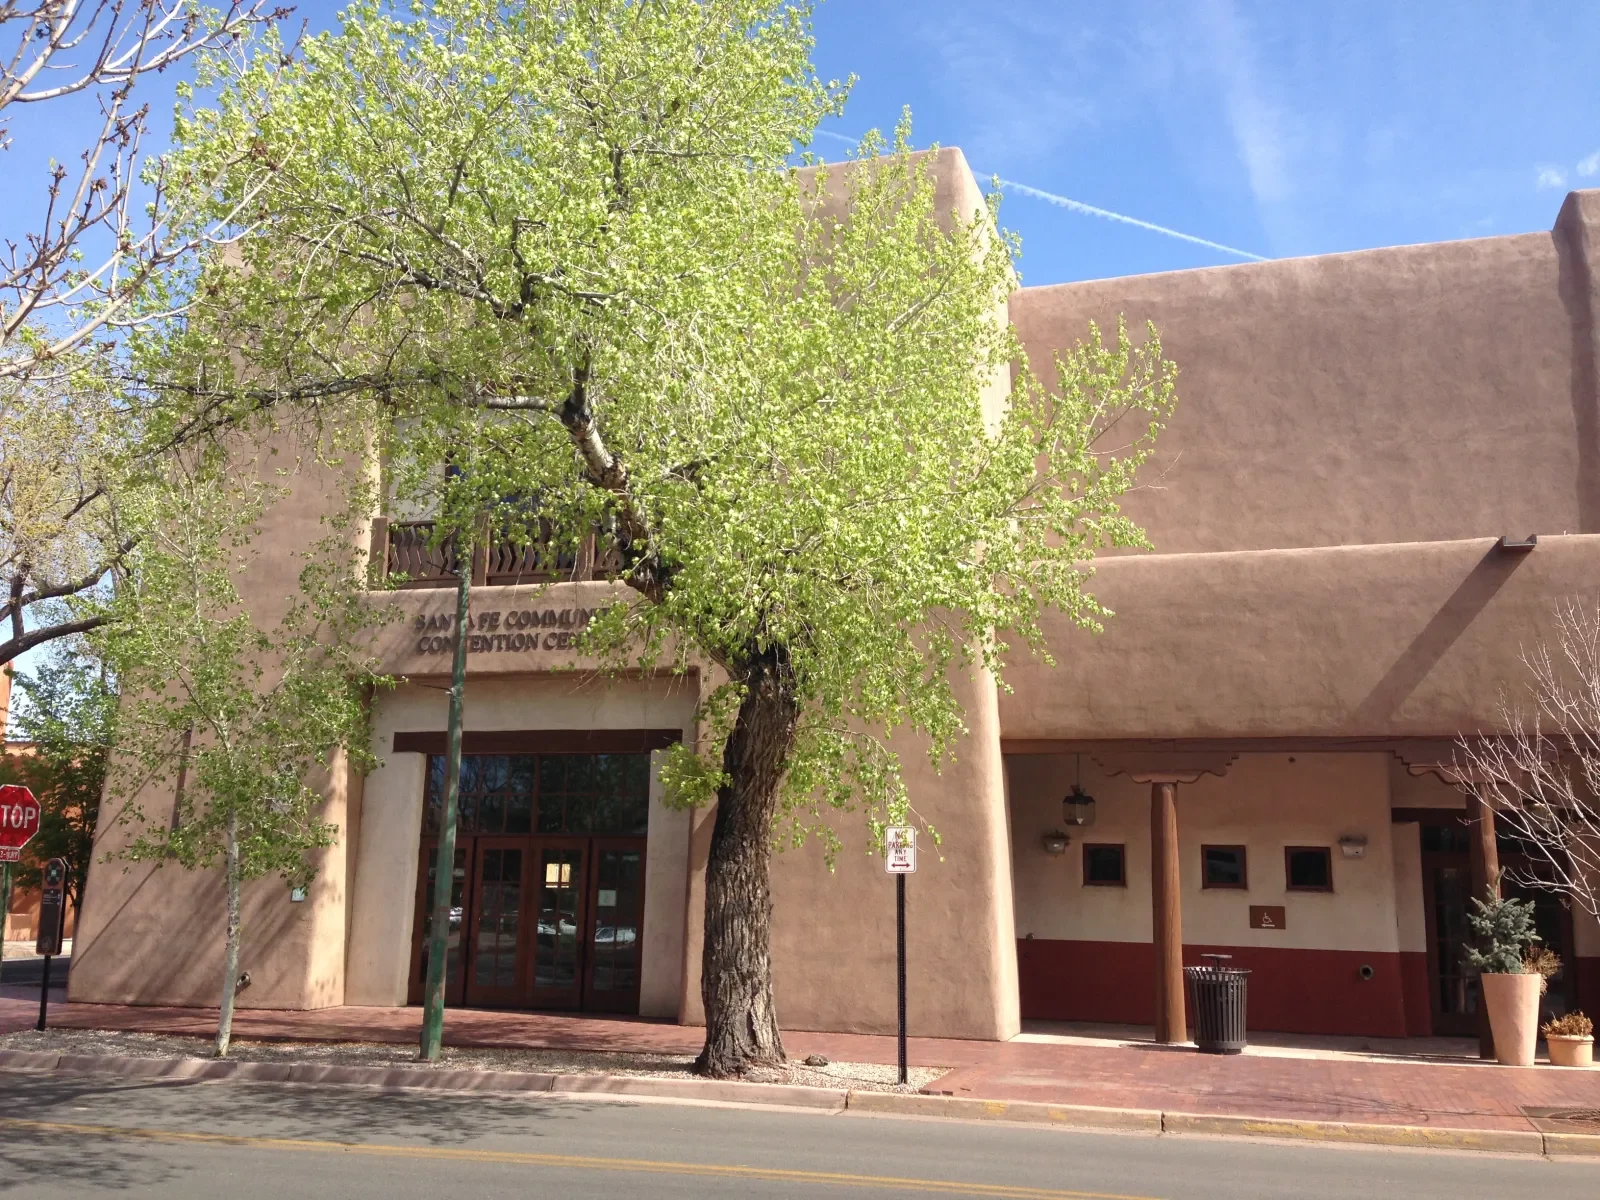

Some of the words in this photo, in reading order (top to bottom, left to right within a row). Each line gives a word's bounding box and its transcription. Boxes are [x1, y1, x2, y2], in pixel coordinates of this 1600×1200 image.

[415, 613, 475, 630] SANA
[477, 611, 501, 632] FE
[416, 633, 540, 655] CONENTION
[0, 805, 36, 829] TOP
[888, 841, 913, 849] PARKNG
